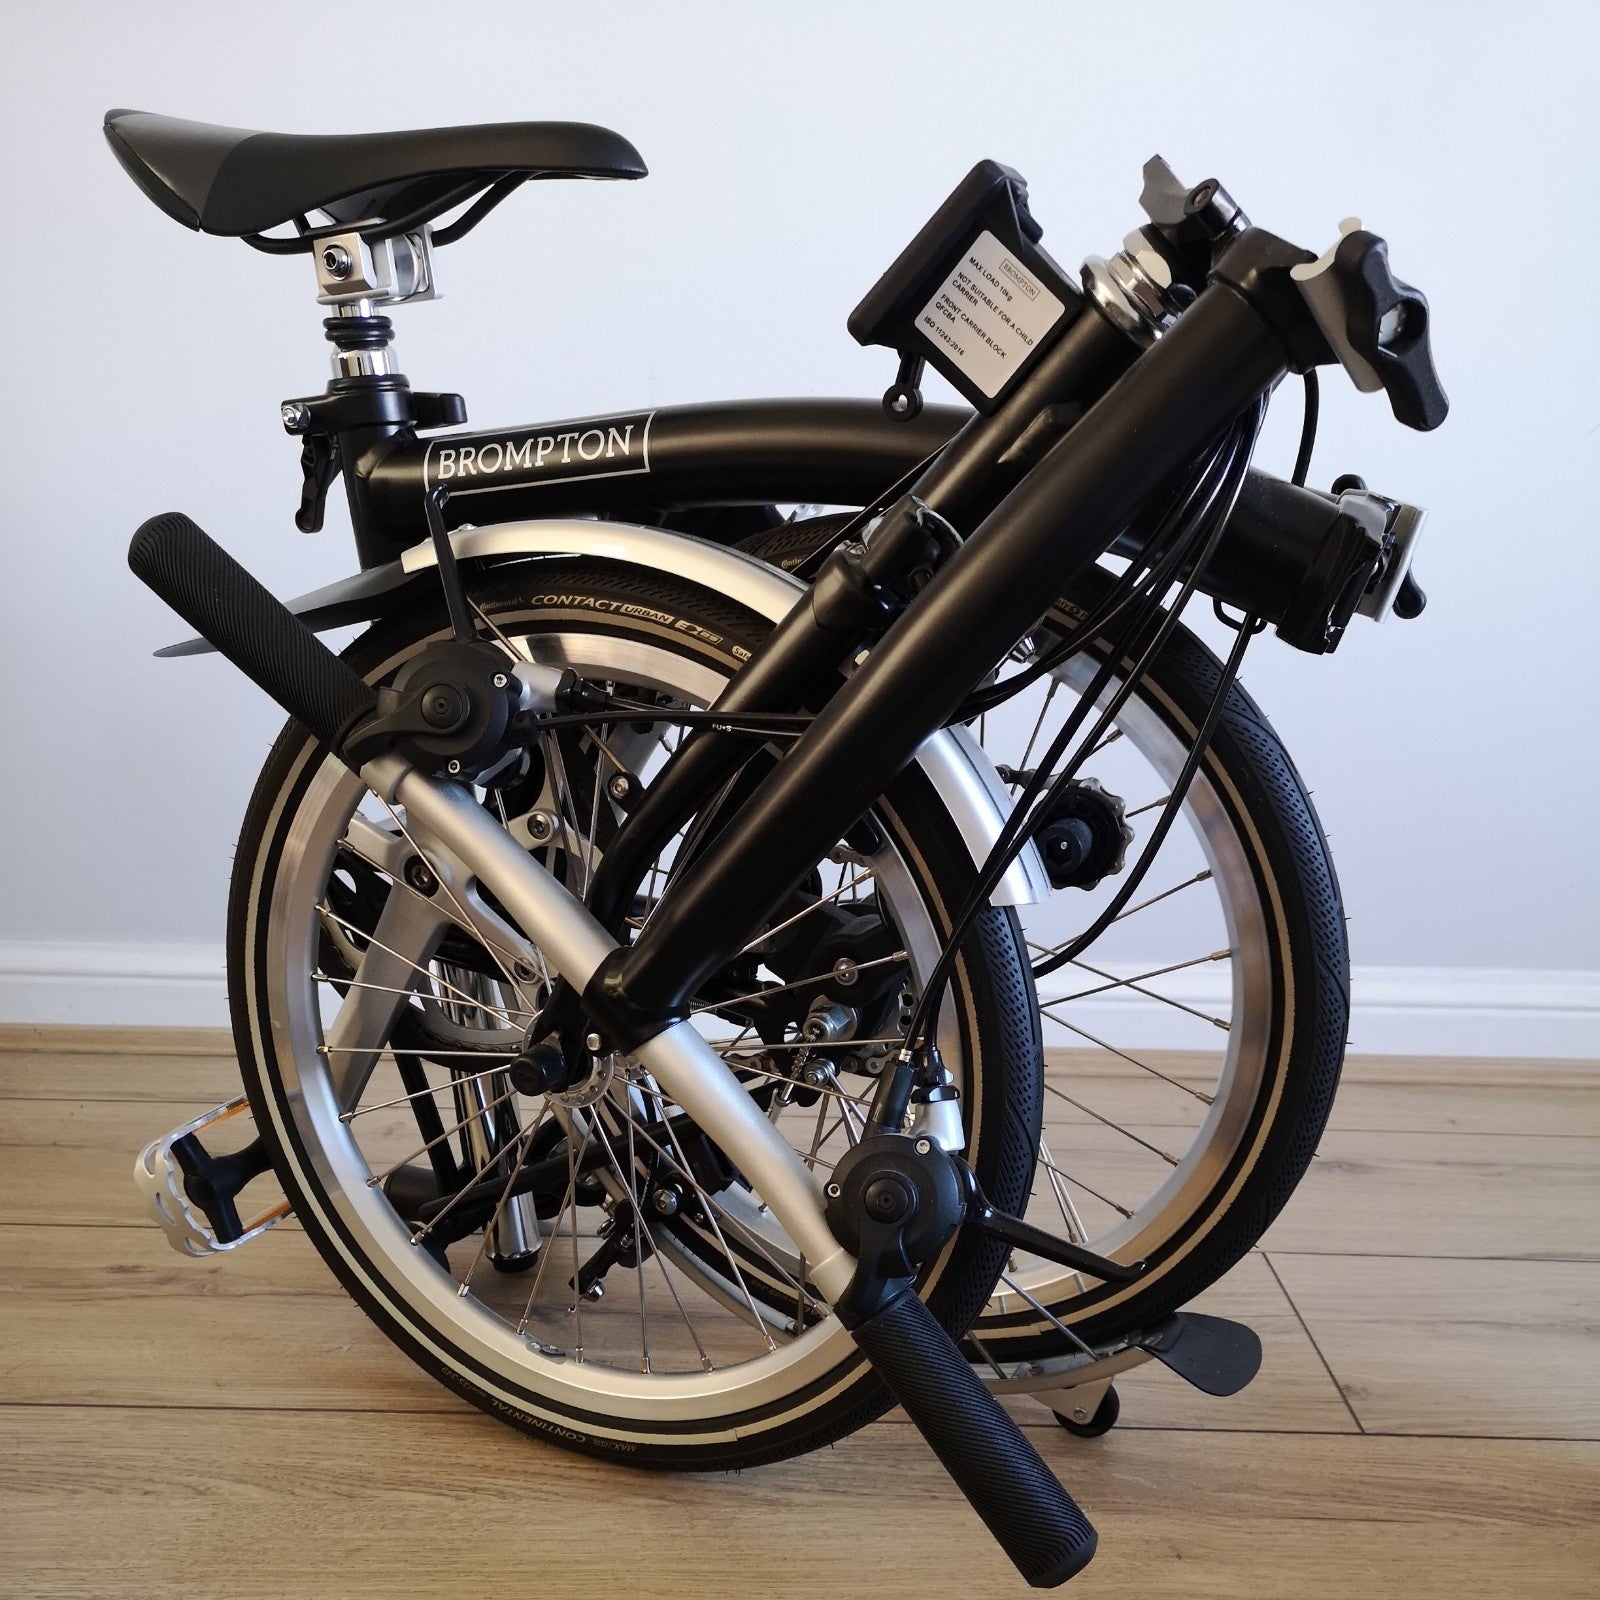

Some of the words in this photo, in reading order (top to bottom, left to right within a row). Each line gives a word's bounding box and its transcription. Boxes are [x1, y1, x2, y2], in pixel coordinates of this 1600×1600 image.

[951, 279, 979, 307] CARRIER
[968, 257, 983, 272] MAX
[982, 270, 1000, 288] LOAD
[1000, 286, 1013, 302] 10kg
[1003, 264, 1037, 297] BROMPTON
[923, 315, 936, 329] ISO
[935, 301, 956, 324] QFCBA
[940, 293, 963, 317] FRONT
[960, 313, 987, 340] CARRIER
[986, 337, 1007, 359] BLOCK
[957, 271, 971, 284] NOT
[970, 283, 999, 313] SUITABLE
[998, 310, 1012, 326] FOR
[1015, 327, 1034, 347] CHILD
[437, 424, 635, 480] BROMPTON
[531, 595, 625, 612] CONTACT
[624, 605, 671, 624] URBAN
[491, 1398, 587, 1444] CONTINENTAL
